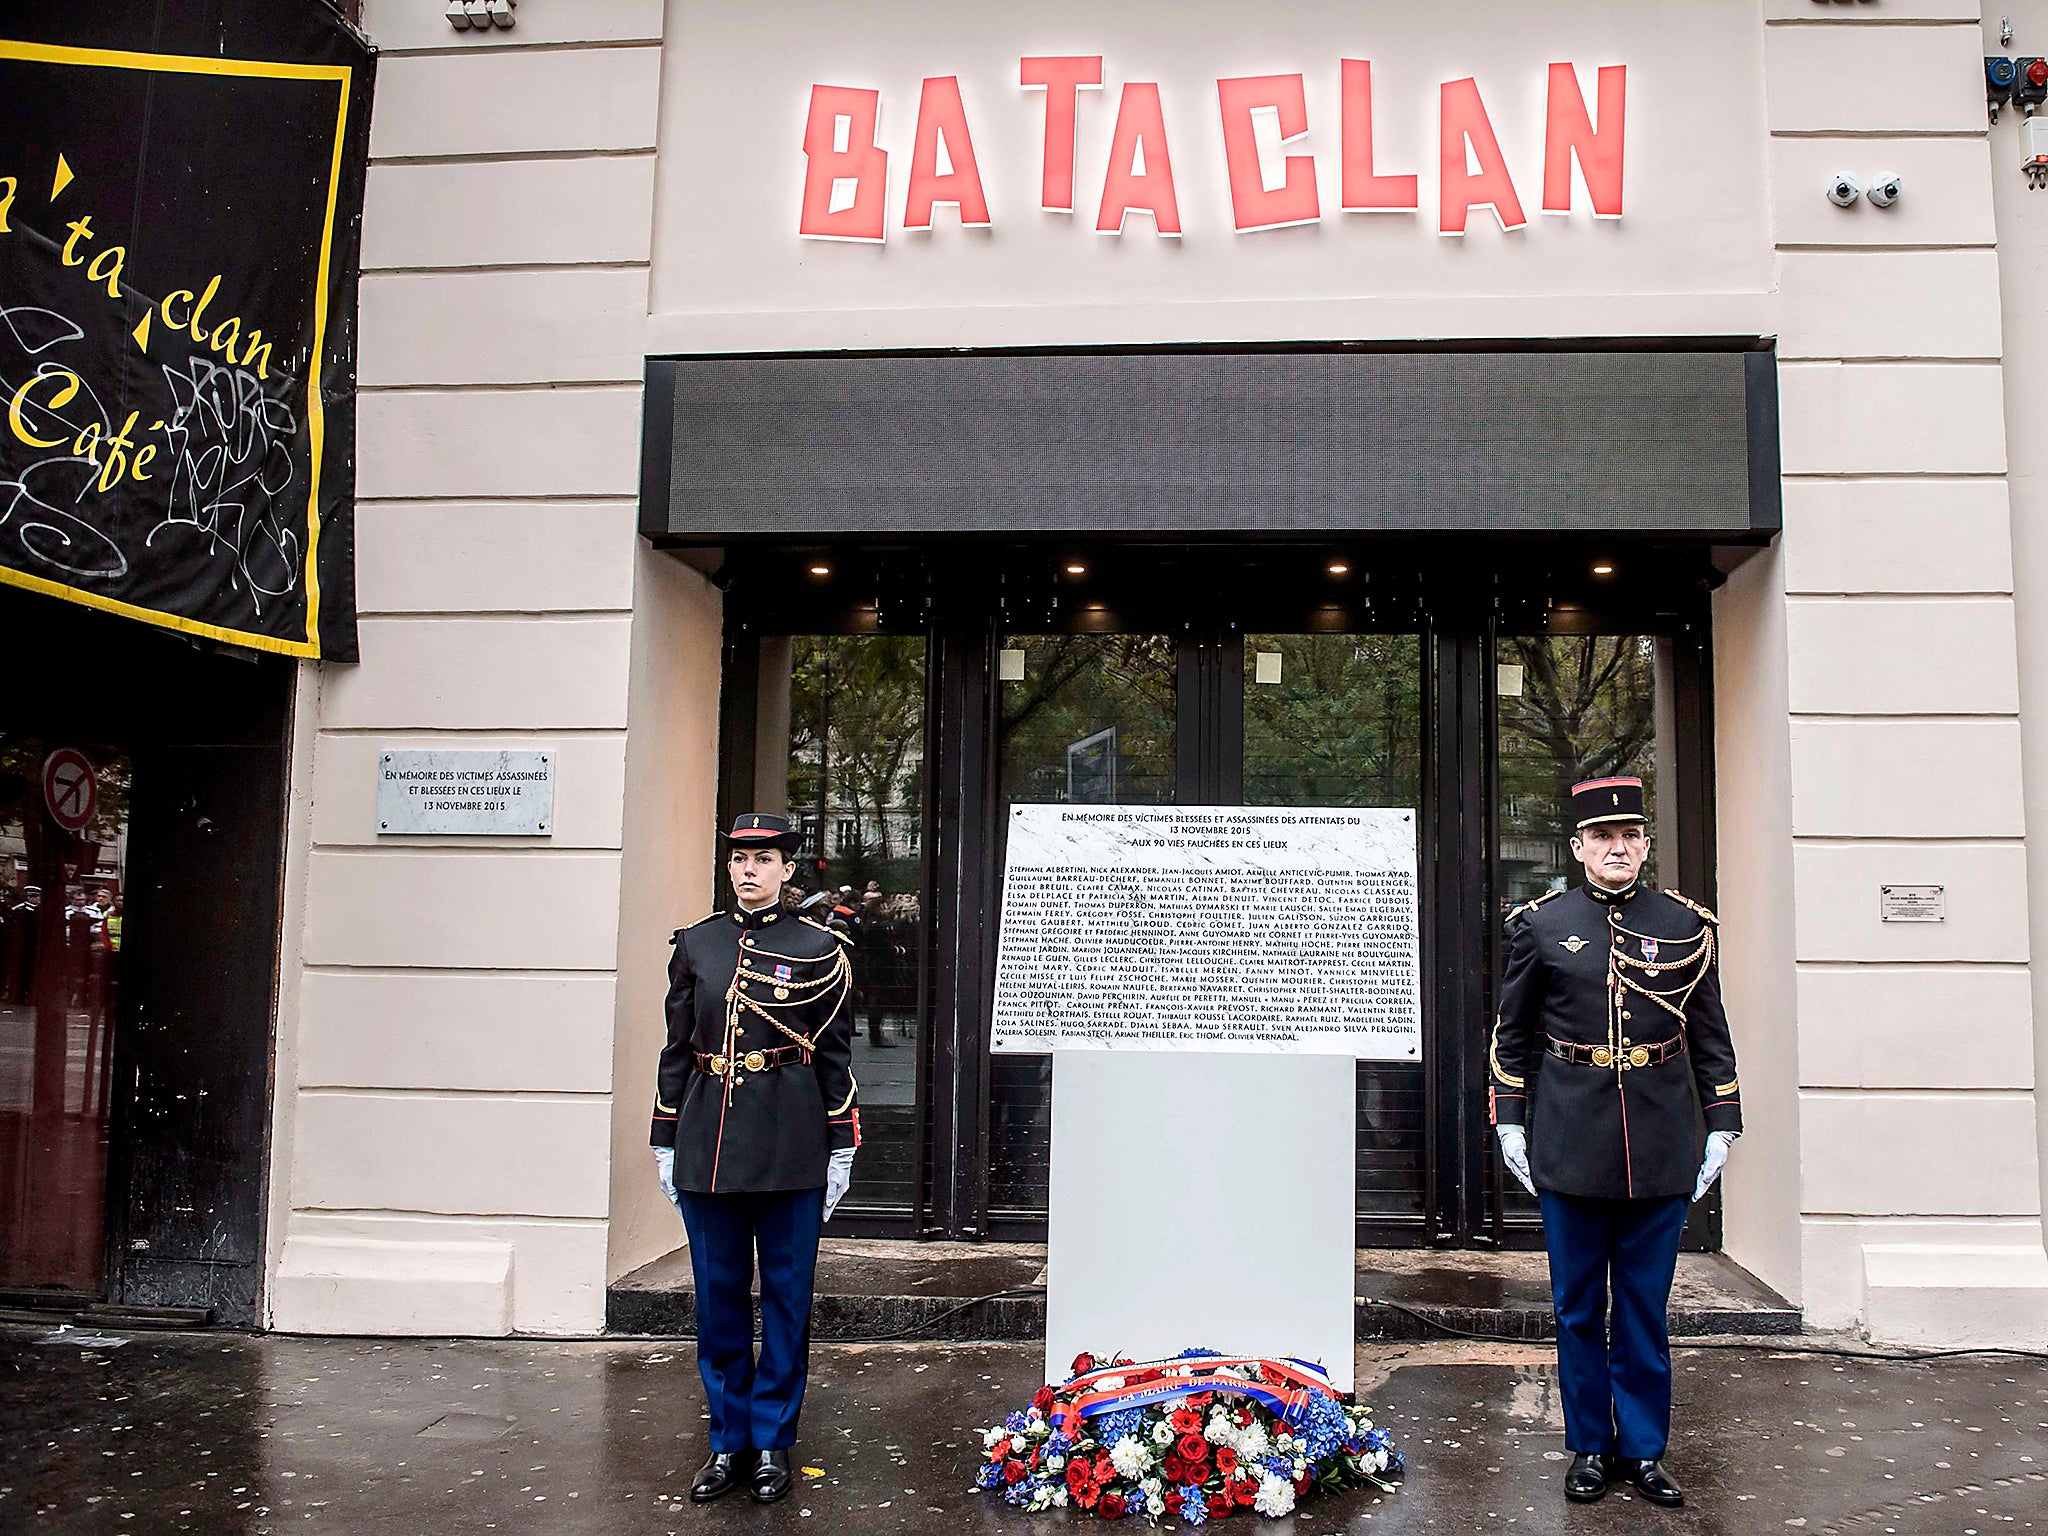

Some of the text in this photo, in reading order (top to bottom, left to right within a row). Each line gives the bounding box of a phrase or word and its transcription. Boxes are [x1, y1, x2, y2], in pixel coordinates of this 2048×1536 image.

[799, 55, 1627, 243] BATACLAN
[9, 371, 165, 492] Café
[385, 770, 548, 781] EN MÉMOIRE DES VICTIMES ASSASSINÉES
[409, 786, 521, 796] ET BLESSÉES EN CES LIEUX LE
[424, 802, 505, 811] 13 NOVEMBRE 2015
[1075, 813, 1115, 821] MÉMOIRE
[1175, 814, 1212, 822] BLESSÉES
[1226, 814, 1278, 823] ASSASSINÉES
[1187, 839, 1229, 847] FAUCHÉES
[1118, 1377, 1250, 1404] LA MAIRE DE PARIS
